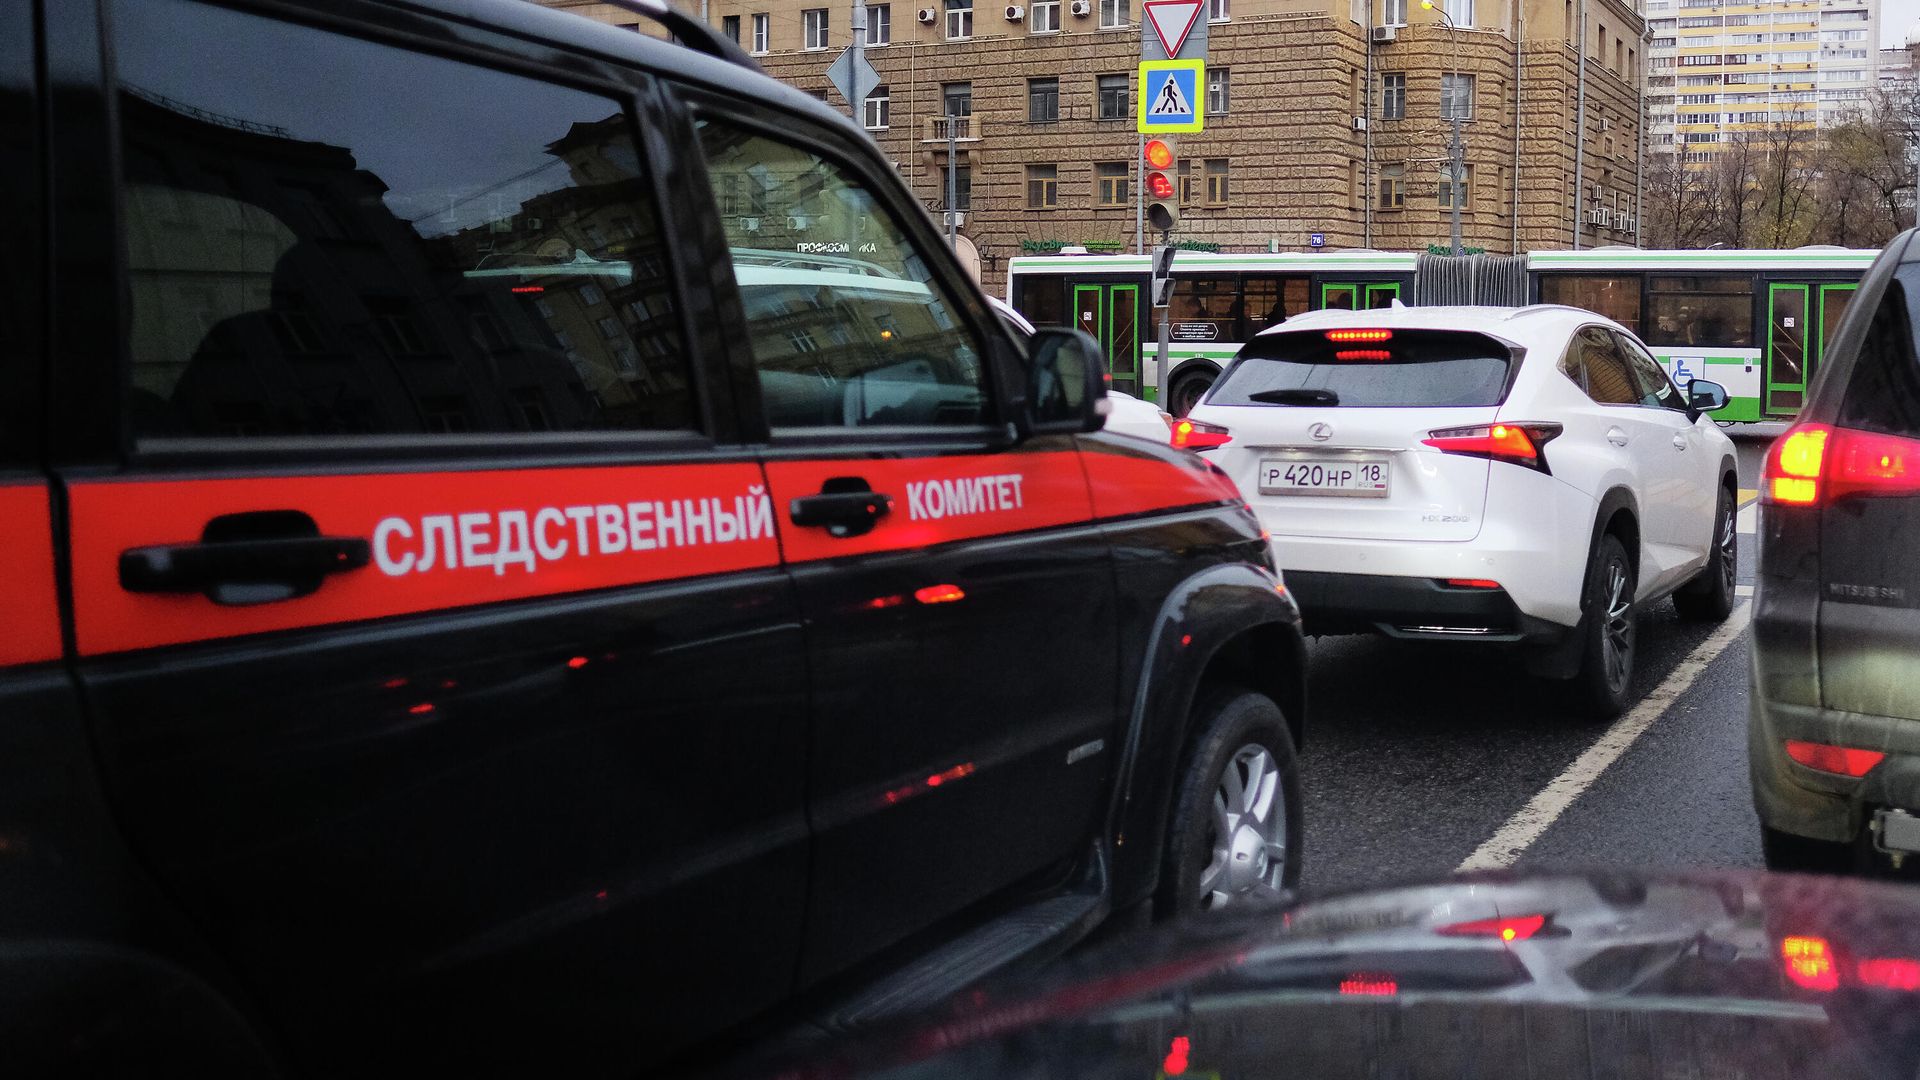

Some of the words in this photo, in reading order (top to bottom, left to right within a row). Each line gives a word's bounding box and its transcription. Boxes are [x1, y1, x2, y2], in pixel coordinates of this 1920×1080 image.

[1312, 236, 1321, 244] 76
[797, 242, 877, 253] ПРОФКОСМИКА
[1361, 465, 1380, 481] 18
[373, 484, 775, 577] СЛЕДСТВЕННЫЙ
[906, 473, 1024, 521] КОМИТЕТ
